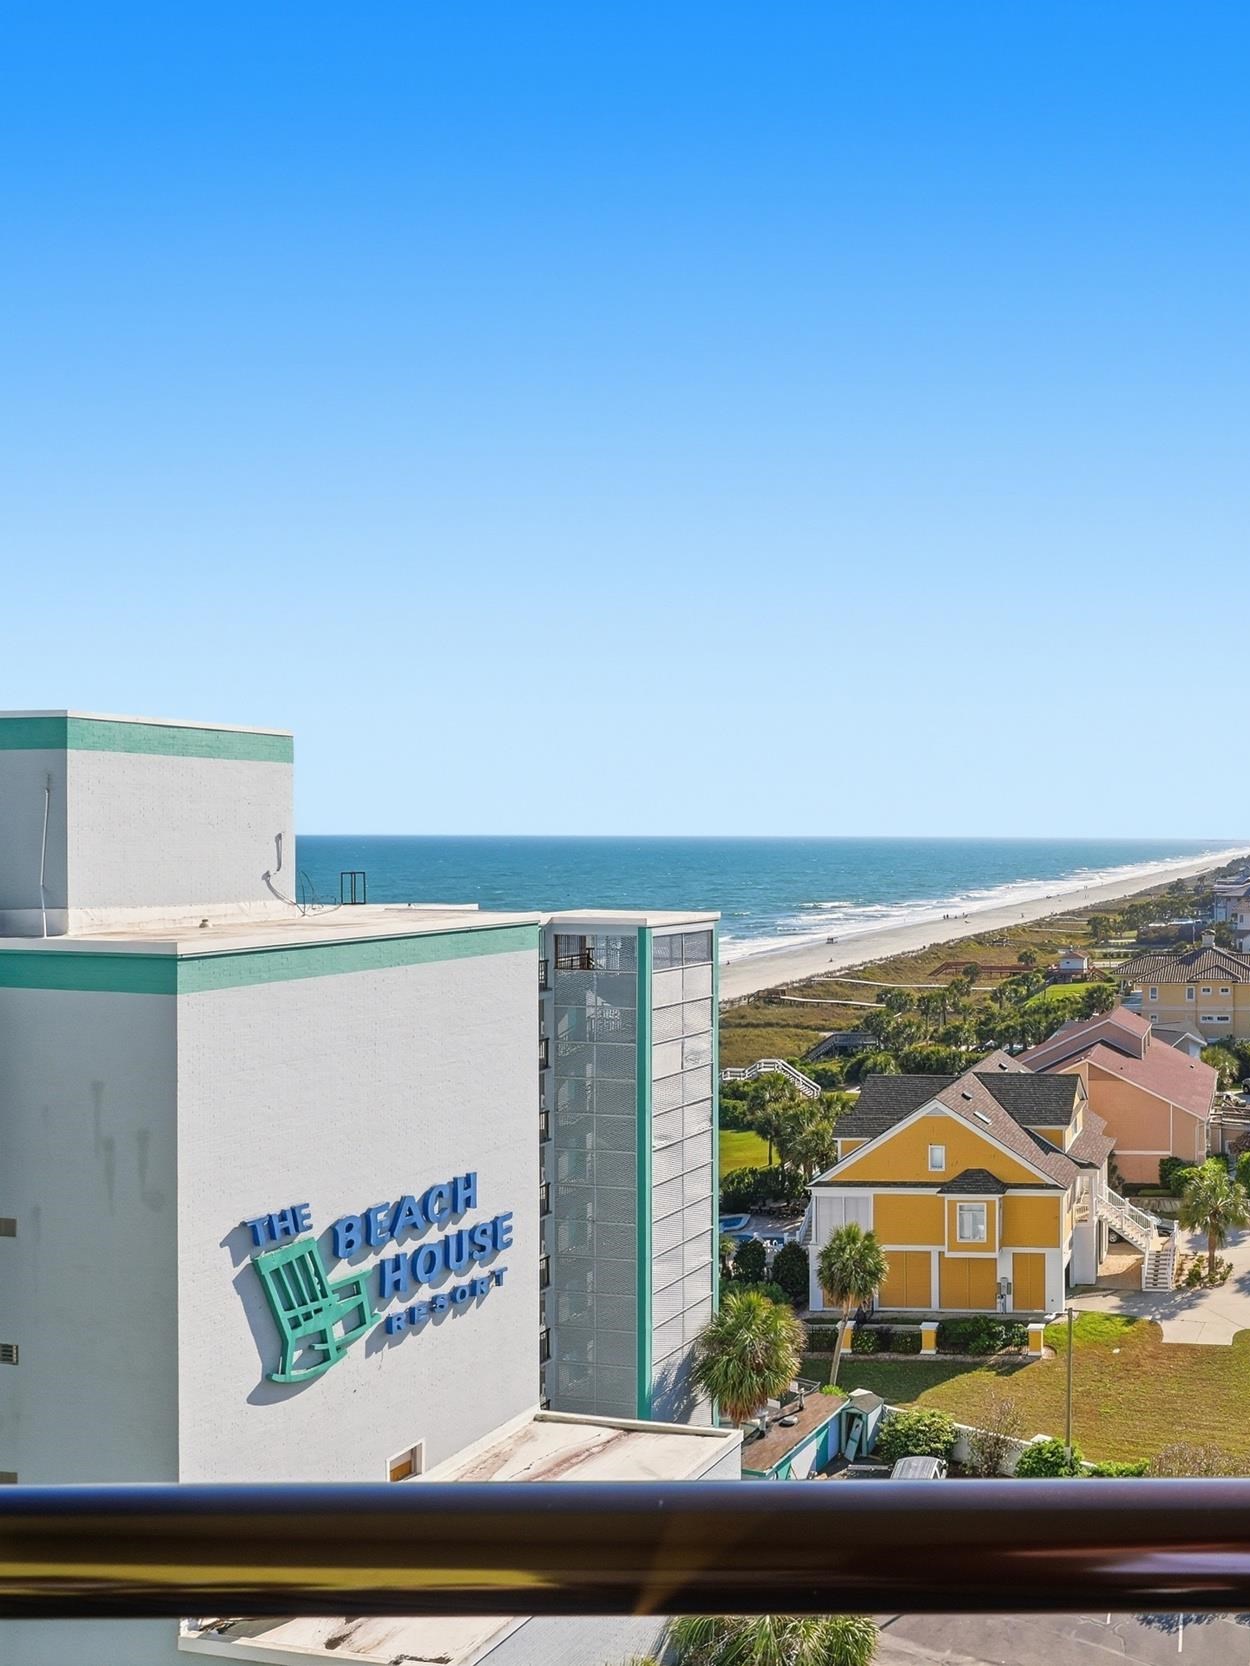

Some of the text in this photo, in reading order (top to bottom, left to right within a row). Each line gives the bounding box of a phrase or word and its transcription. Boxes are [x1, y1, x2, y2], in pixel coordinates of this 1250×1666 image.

[247, 1172, 477, 1259] THE BEACH
[379, 1211, 513, 1299] HOUSE
[386, 1266, 508, 1335] RESORT
